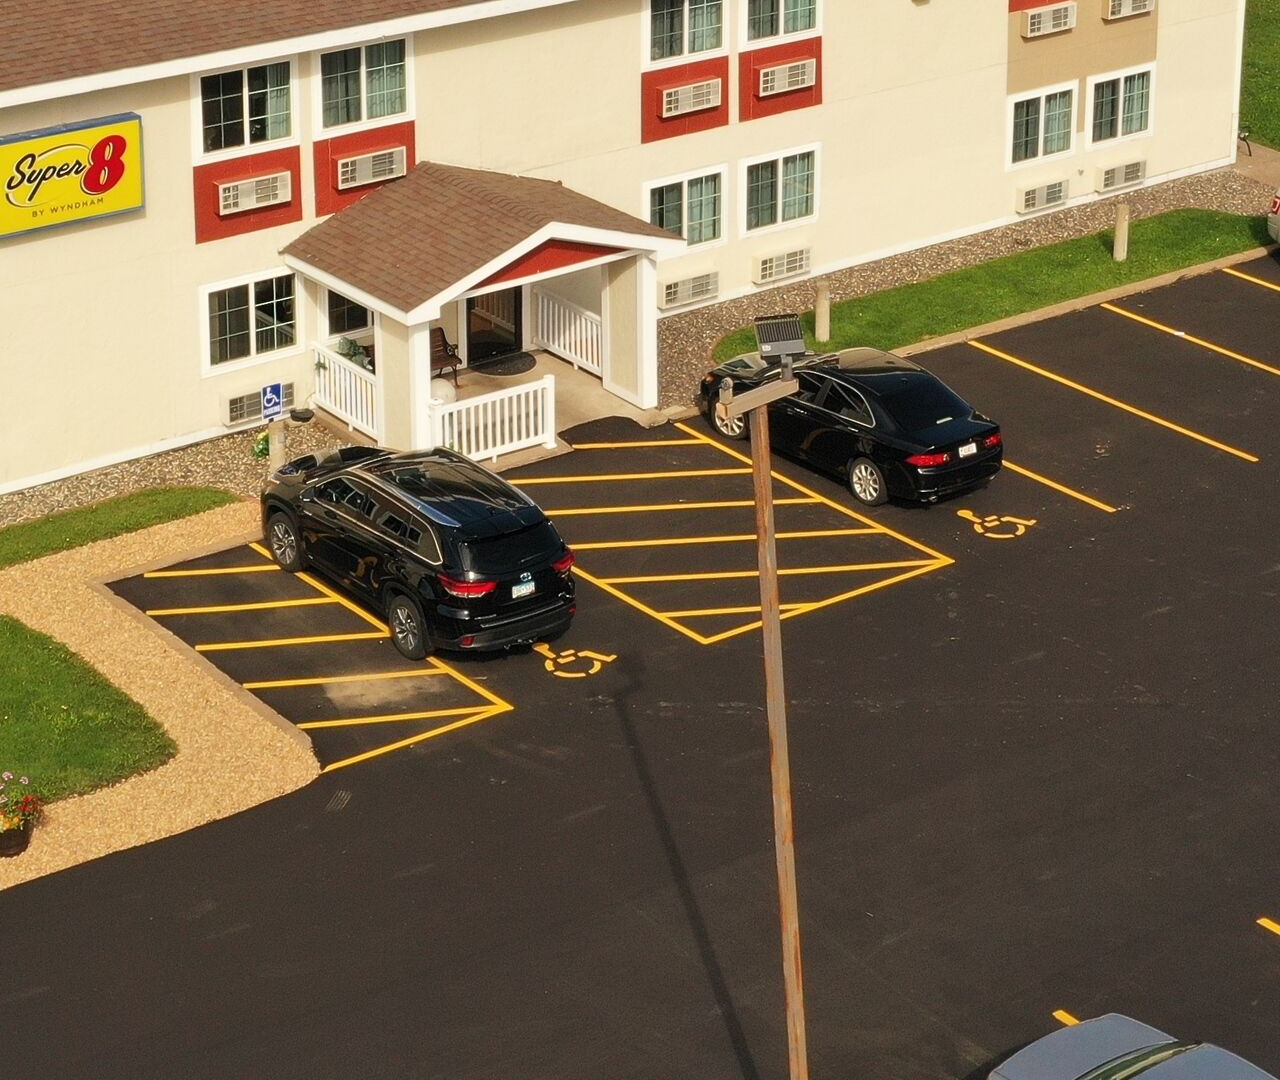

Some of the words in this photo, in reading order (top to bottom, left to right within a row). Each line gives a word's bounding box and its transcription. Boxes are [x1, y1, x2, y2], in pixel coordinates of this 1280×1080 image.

[6, 153, 87, 202] Super
[81, 134, 127, 195] 8
[31, 209, 45, 218] BY
[50, 197, 104, 214] WYNDHAM
